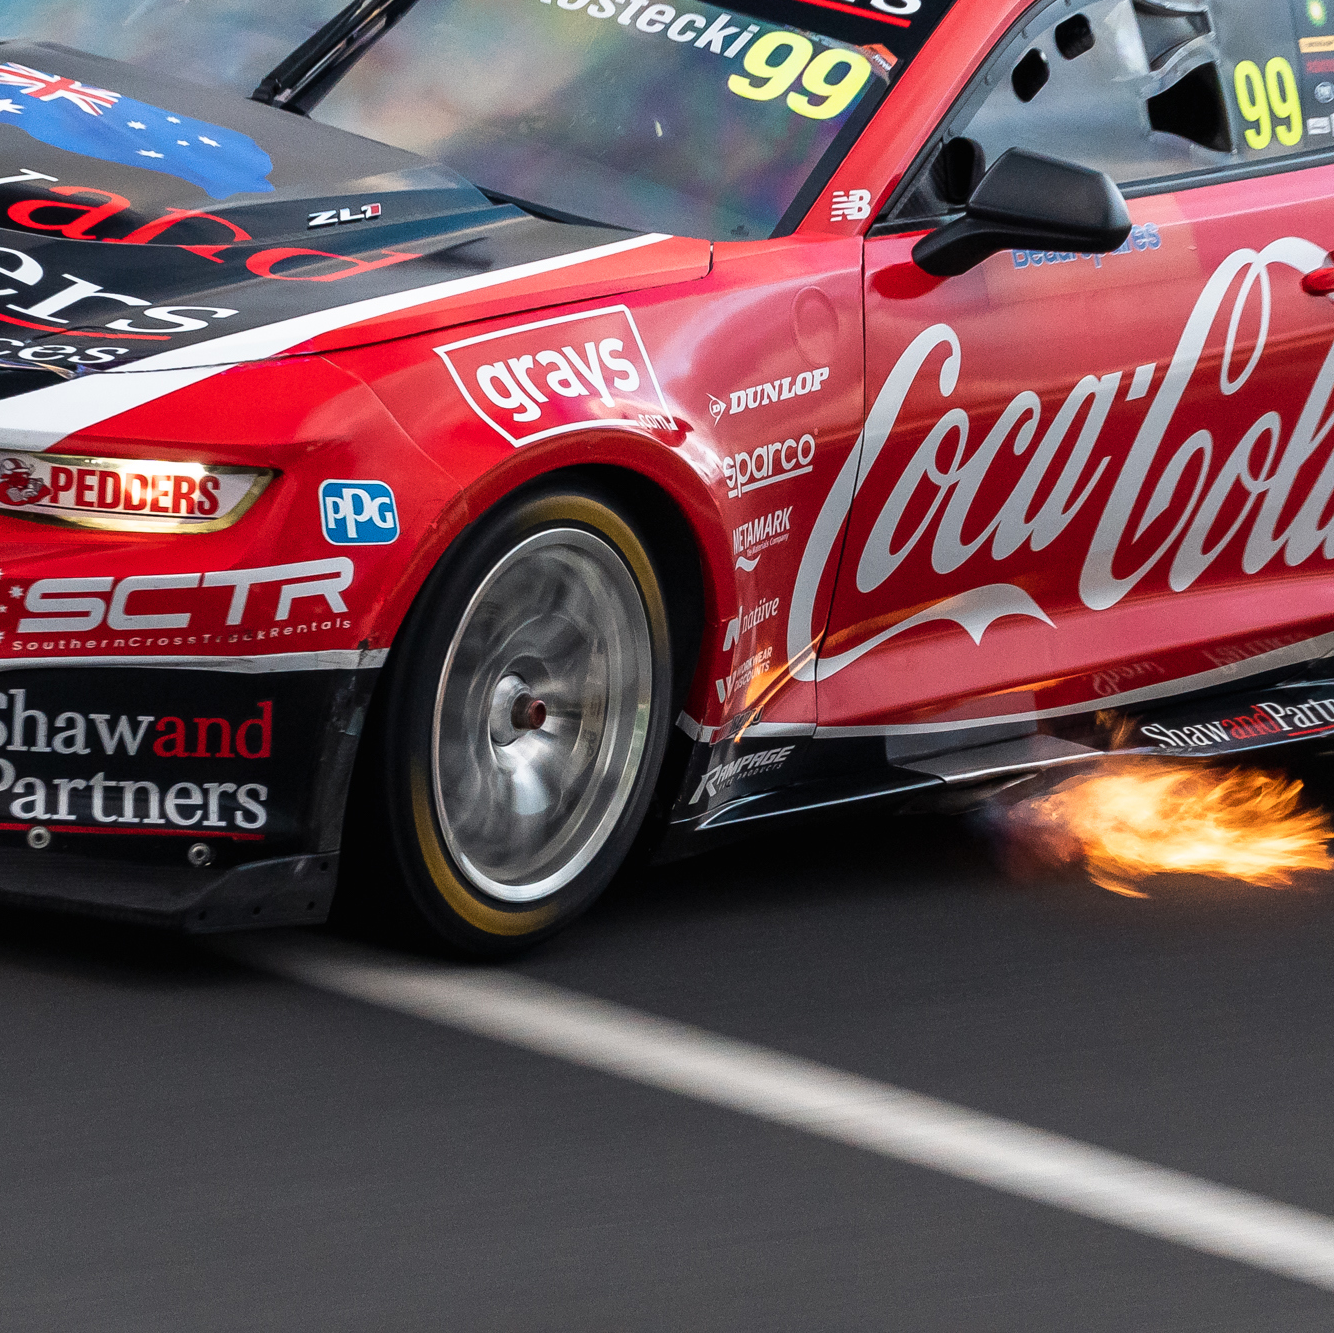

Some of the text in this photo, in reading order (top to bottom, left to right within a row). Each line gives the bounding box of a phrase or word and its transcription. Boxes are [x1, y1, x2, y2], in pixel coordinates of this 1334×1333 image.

[727, 30, 873, 120] 99
[1233, 56, 1304, 150] 99
[307, 202, 382, 227] ZL1
[475, 337, 640, 422] grays
[728, 366, 830, 415] DUNLOP
[49, 466, 222, 517] PEDDERS
[722, 433, 816, 498] sparco
[326, 488, 396, 539] PPG
[732, 505, 794, 556] METAMARK
[16, 556, 355, 634] SCTR
[688, 744, 796, 805] RAMPAGE
